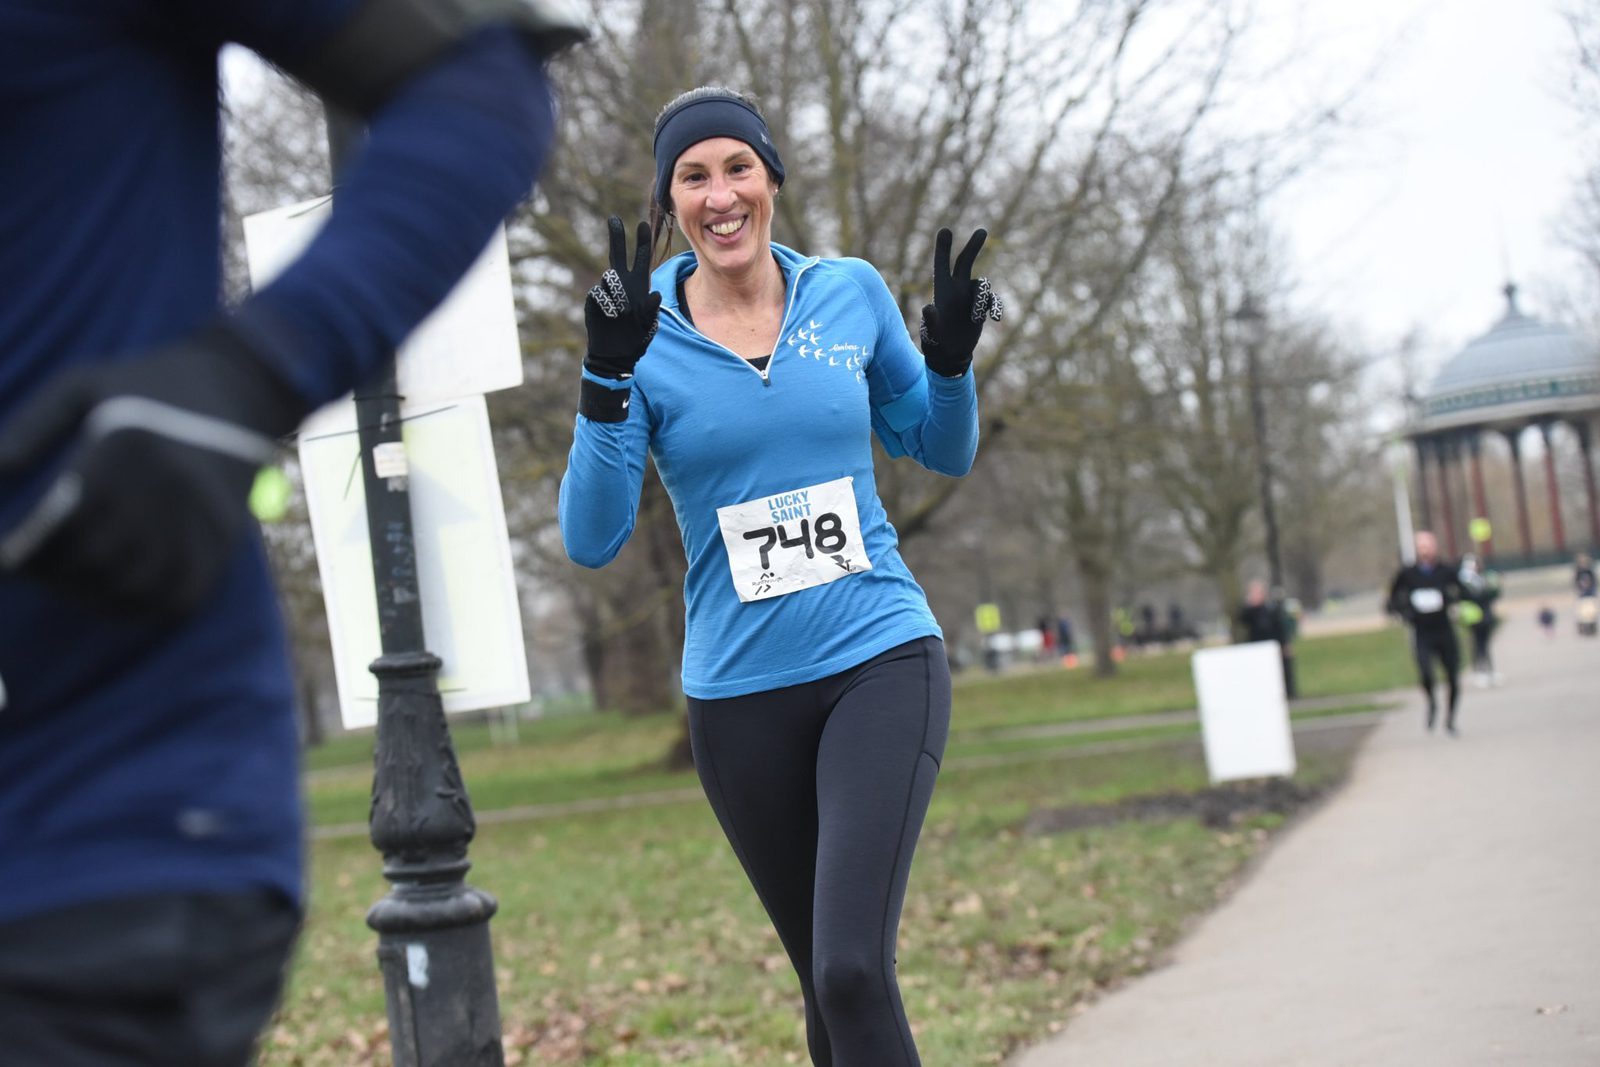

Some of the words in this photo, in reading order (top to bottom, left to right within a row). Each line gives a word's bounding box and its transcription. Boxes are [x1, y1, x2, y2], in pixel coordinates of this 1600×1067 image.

[768, 490, 808, 510] LUCKY
[771, 503, 811, 524] SAINT
[743, 512, 846, 570] 748
